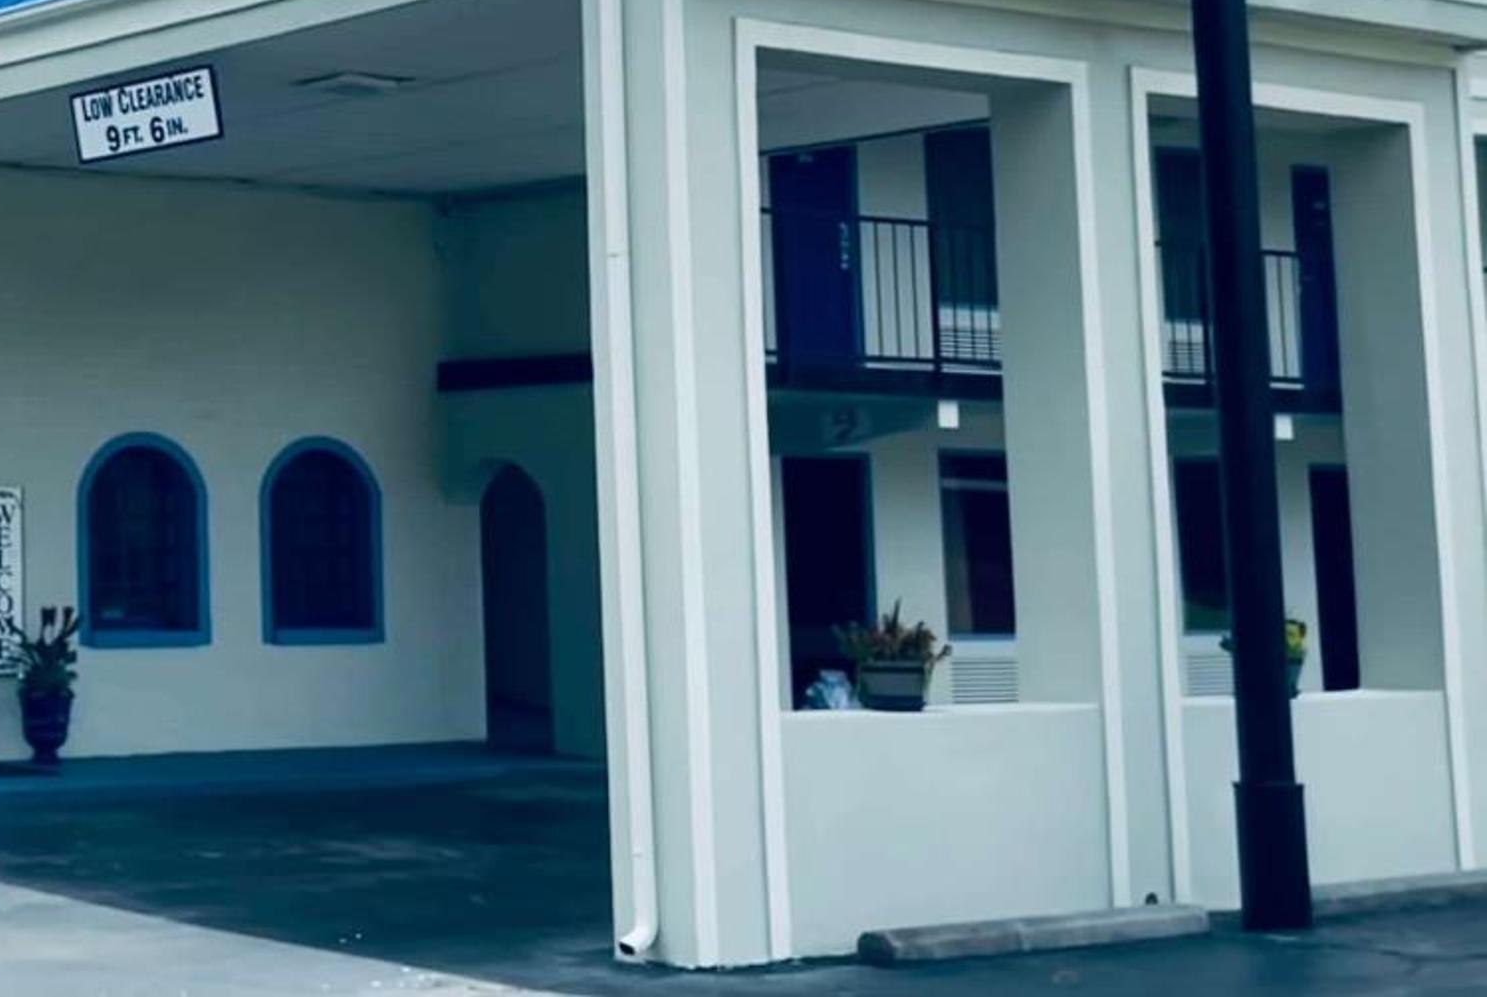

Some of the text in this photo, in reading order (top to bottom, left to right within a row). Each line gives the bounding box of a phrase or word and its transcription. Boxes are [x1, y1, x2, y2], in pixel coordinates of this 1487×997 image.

[82, 75, 205, 122] LOW CLEARANCE
[105, 116, 188, 152] 9 FT. 6 IN.
